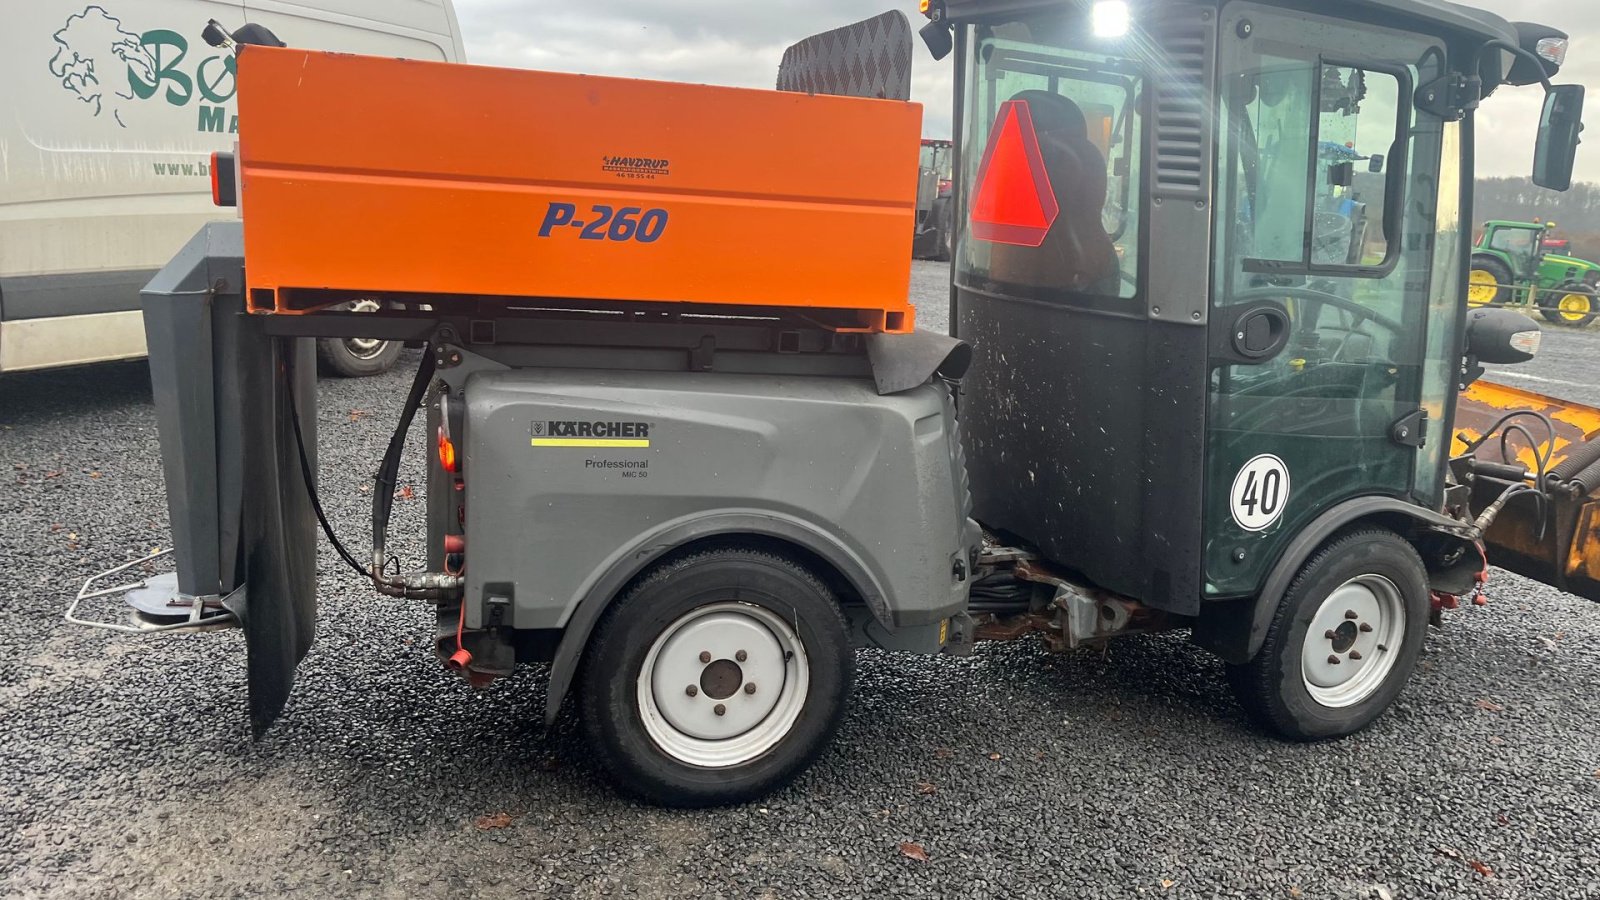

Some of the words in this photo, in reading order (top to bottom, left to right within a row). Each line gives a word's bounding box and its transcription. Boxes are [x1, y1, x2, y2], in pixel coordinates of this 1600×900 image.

[609, 156, 669, 170] HAVDRUP
[538, 202, 669, 243] P-260
[548, 421, 649, 437] KÄRCHER
[585, 459, 648, 469] Professional
[1241, 468, 1281, 516] 40
